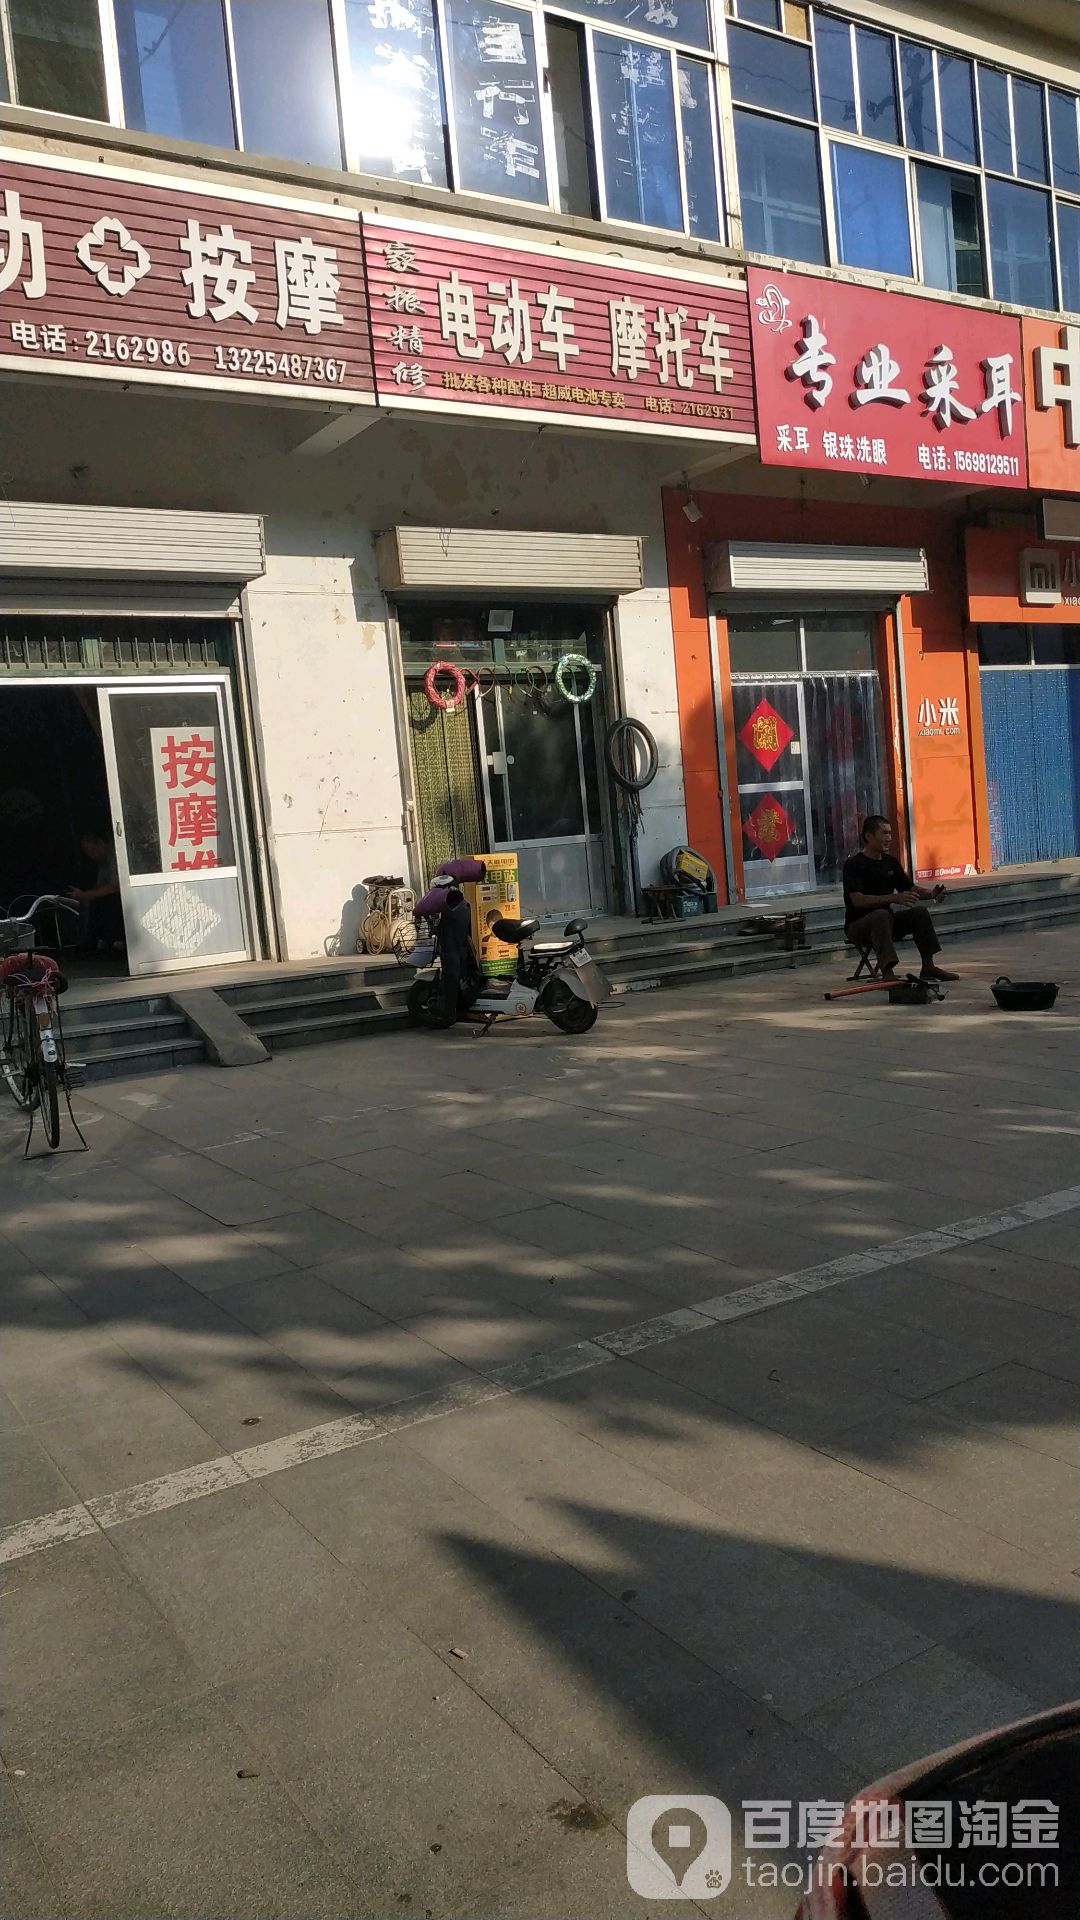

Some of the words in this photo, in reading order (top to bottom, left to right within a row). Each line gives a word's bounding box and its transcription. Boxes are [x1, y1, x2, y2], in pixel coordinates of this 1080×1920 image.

[180, 218, 345, 335] 按摩
[438, 270, 580, 371] 电动车
[608, 296, 734, 392] 摩托车
[215, 346, 347, 383] 13225487367
[790, 314, 1021, 438] 专业采耳
[443, 372, 536, 397] 批发各种配件
[542, 383, 625, 408] 超威电池专卖
[776, 424, 809, 453] 采耳
[822, 431, 888, 465] 银珠洗眼
[918, 696, 959, 727] 小米
